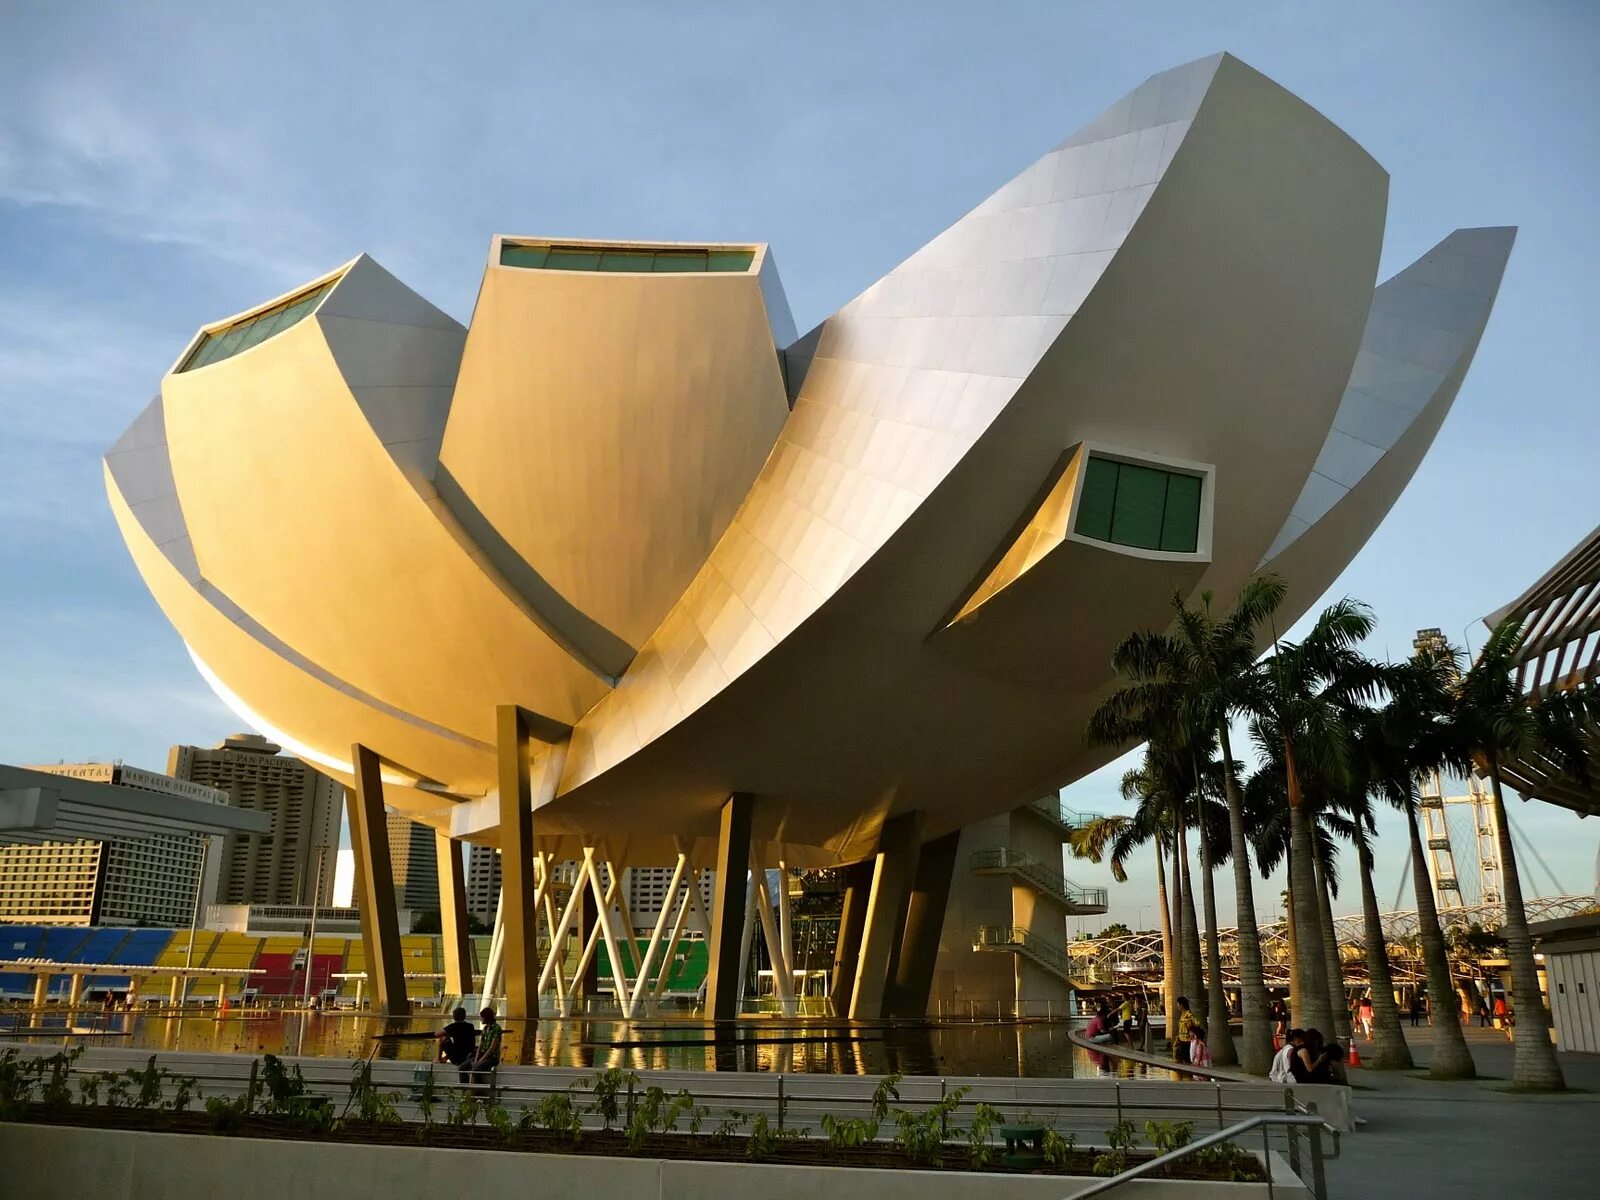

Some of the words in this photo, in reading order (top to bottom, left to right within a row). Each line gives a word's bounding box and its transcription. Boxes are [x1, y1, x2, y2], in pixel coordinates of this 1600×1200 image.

[236, 754, 256, 764] PAN
[258, 756, 295, 767] PACIFIC
[125, 770, 170, 788] MANDARIN
[173, 780, 212, 799] ORIENTAL
